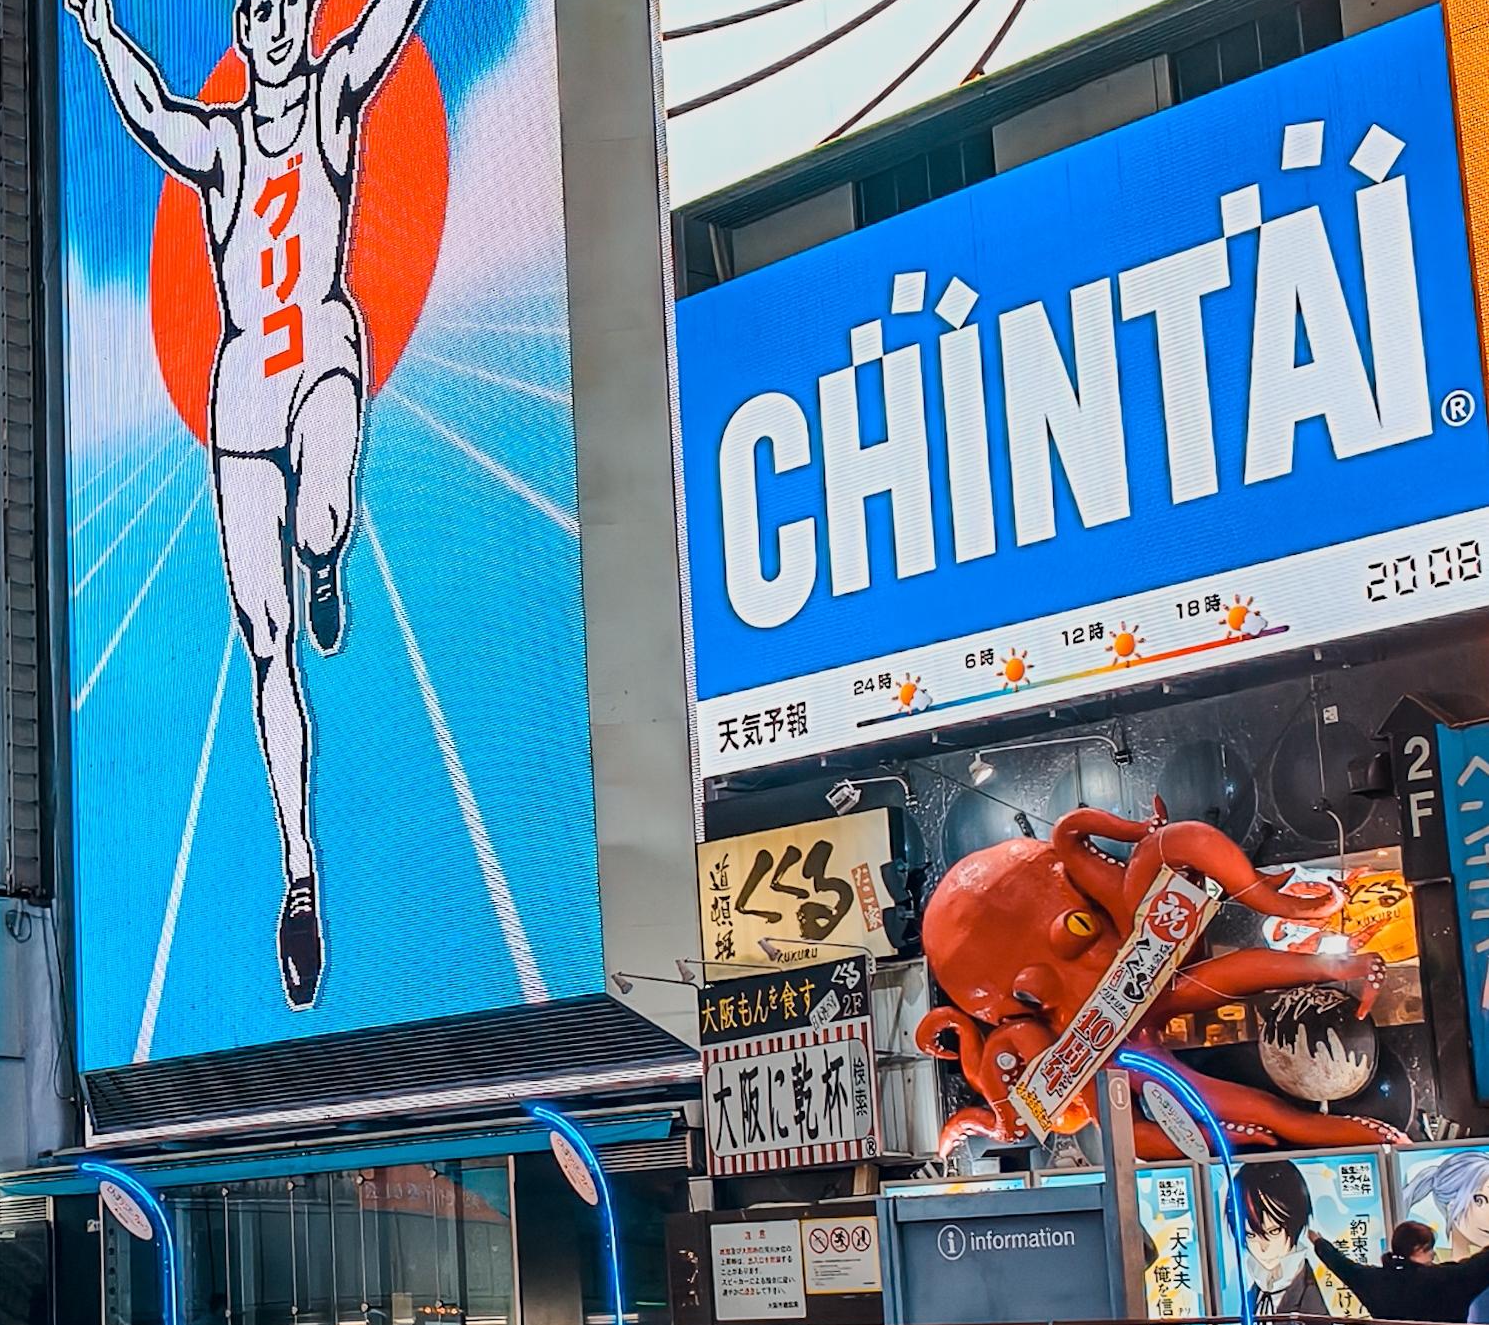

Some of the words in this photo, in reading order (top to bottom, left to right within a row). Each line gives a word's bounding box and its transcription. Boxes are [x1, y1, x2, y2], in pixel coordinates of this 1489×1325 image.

[254, 153, 304, 378] グリコ
[853, 672, 892, 695] 24時
[965, 648, 995, 668] 6時
[1061, 622, 1105, 646] 12時
[1175, 594, 1221, 619] 18時
[718, 701, 809, 753] 天気予報
[709, 853, 736, 961] 道頓堀
[735, 840, 854, 940] くくる
[702, 978, 815, 1034] 大阪もんを食す
[831, 961, 861, 989] くくる
[842, 992, 864, 1017] 2F
[713, 1049, 849, 1151] 大阪に乾杯
[969, 1225, 1075, 1251] information
